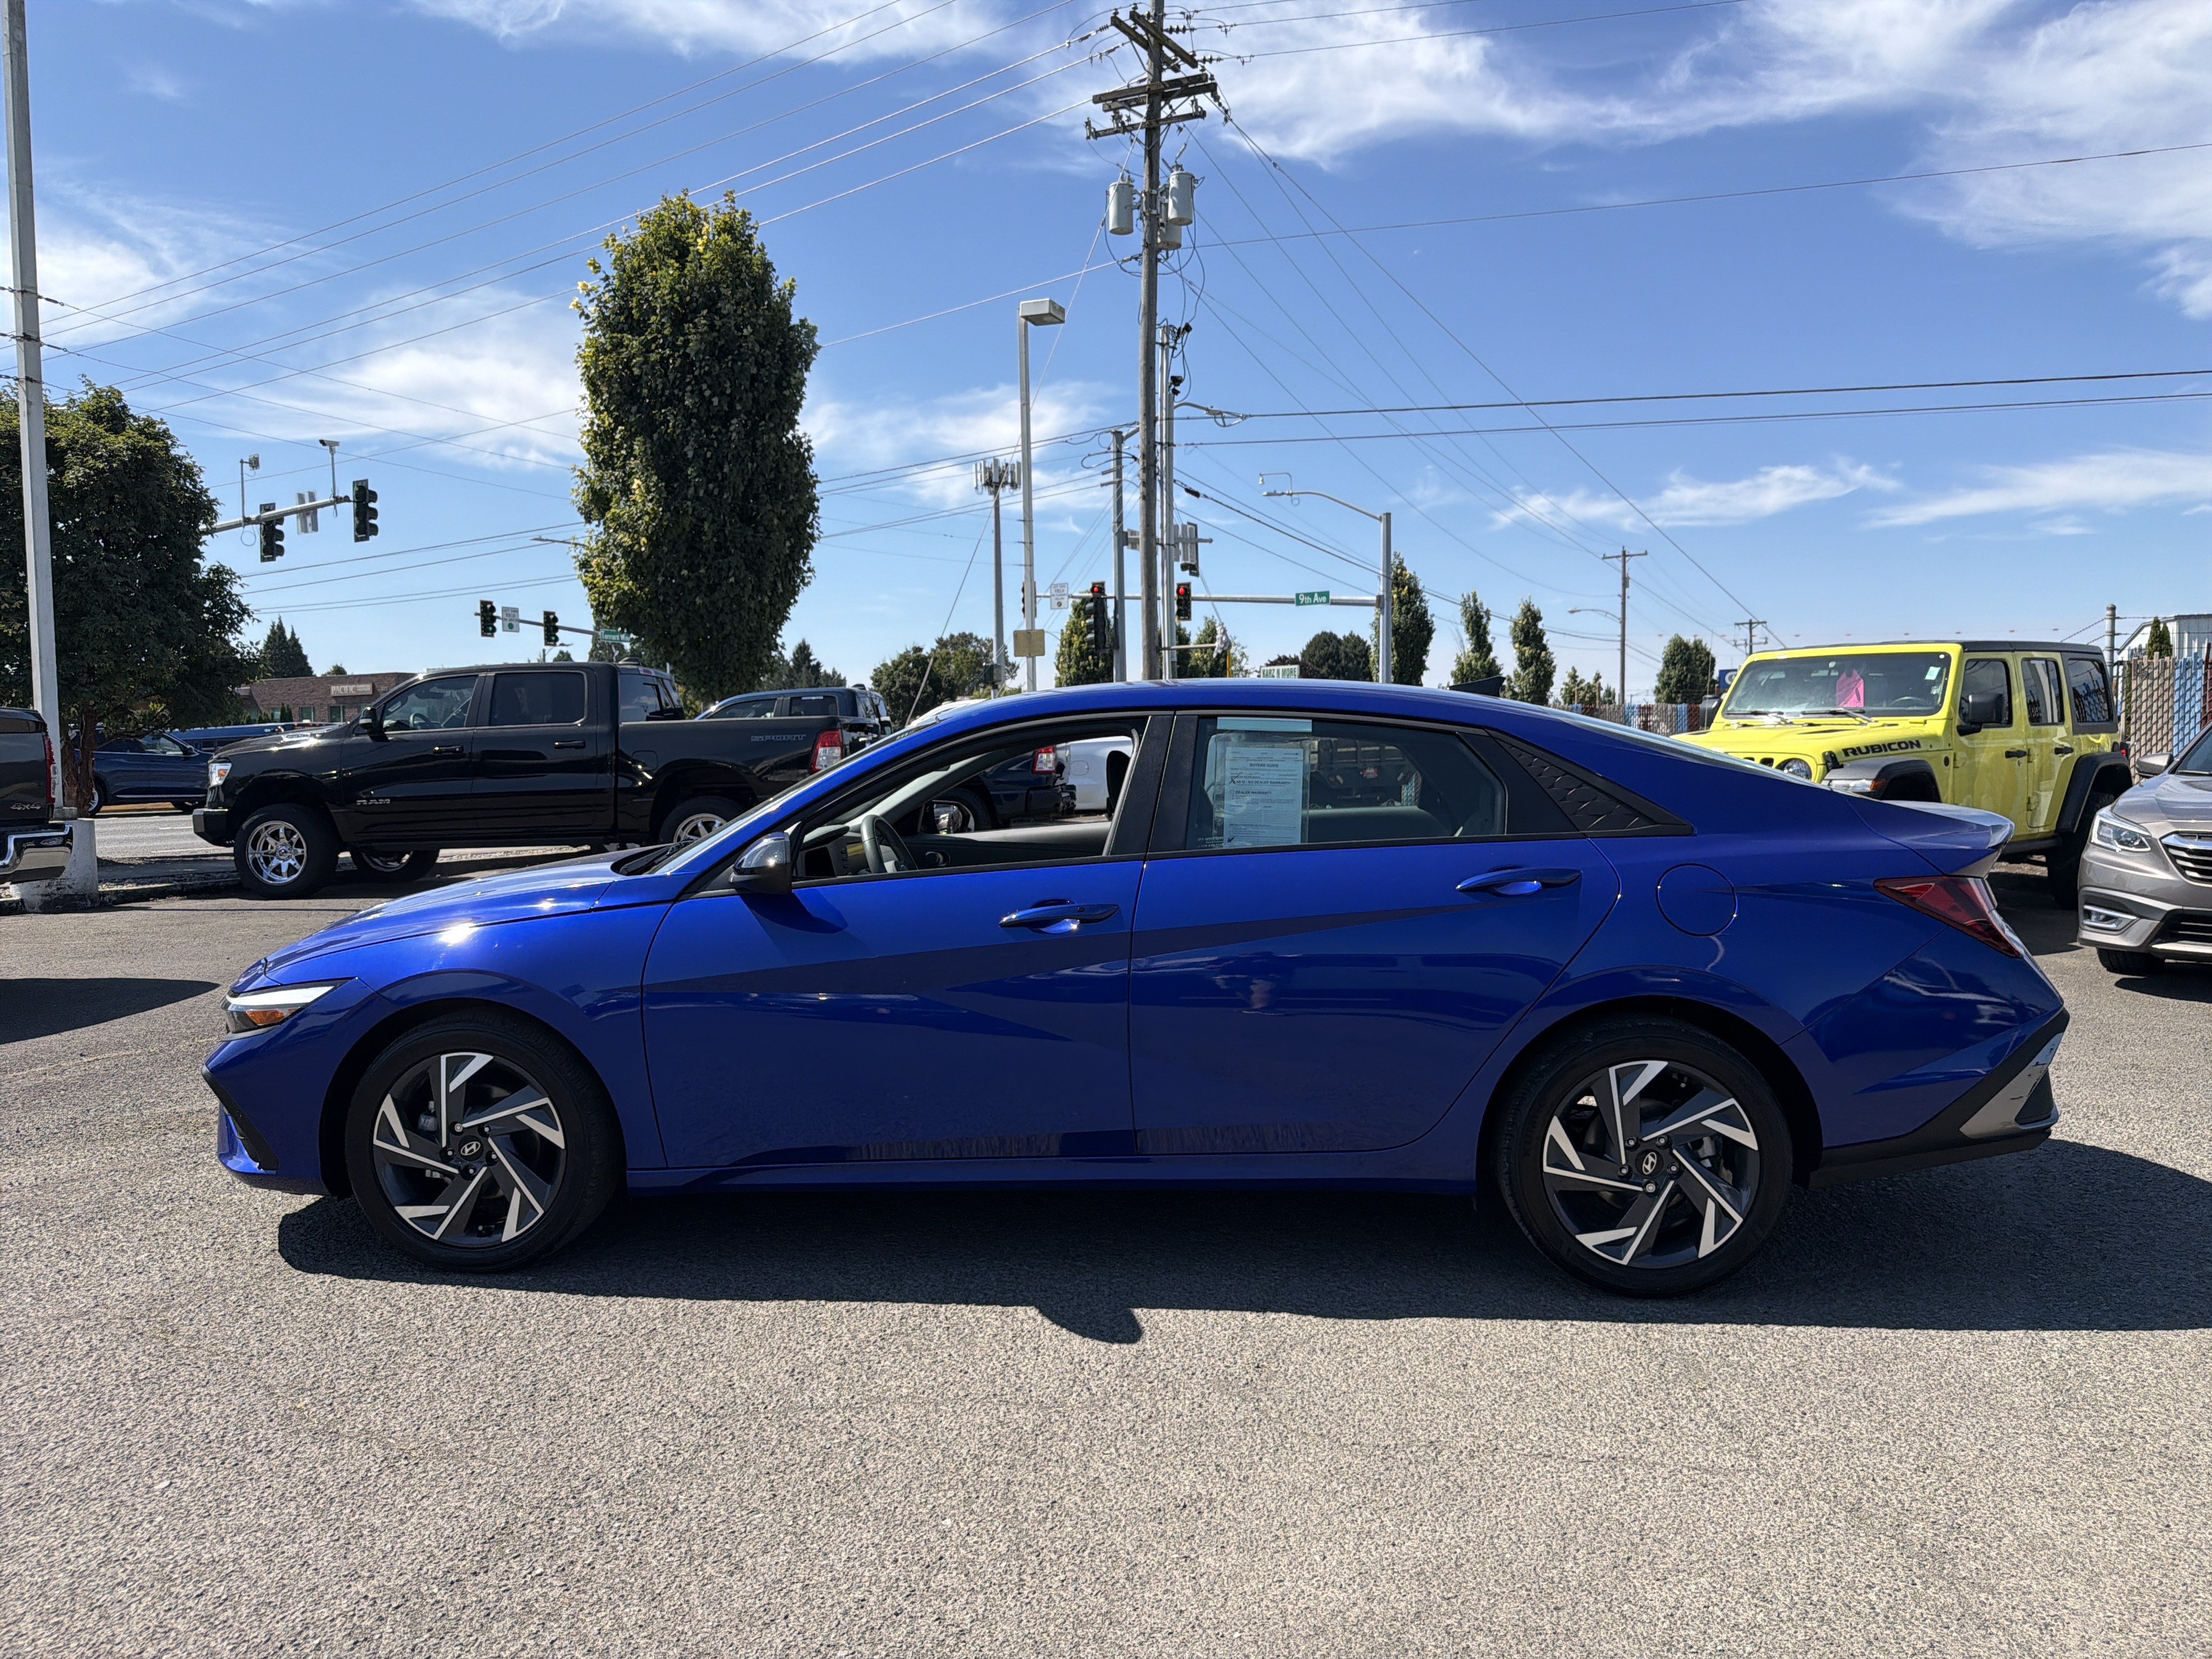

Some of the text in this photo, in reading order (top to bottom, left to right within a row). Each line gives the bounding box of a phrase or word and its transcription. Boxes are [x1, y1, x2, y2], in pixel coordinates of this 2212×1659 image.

[1299, 592, 1327, 604] 9th Ave
[1262, 668, 1296, 678] KARZ N MORE
[331, 685, 356, 695] PACIFIC
[1842, 740, 1922, 757] RUBICON
